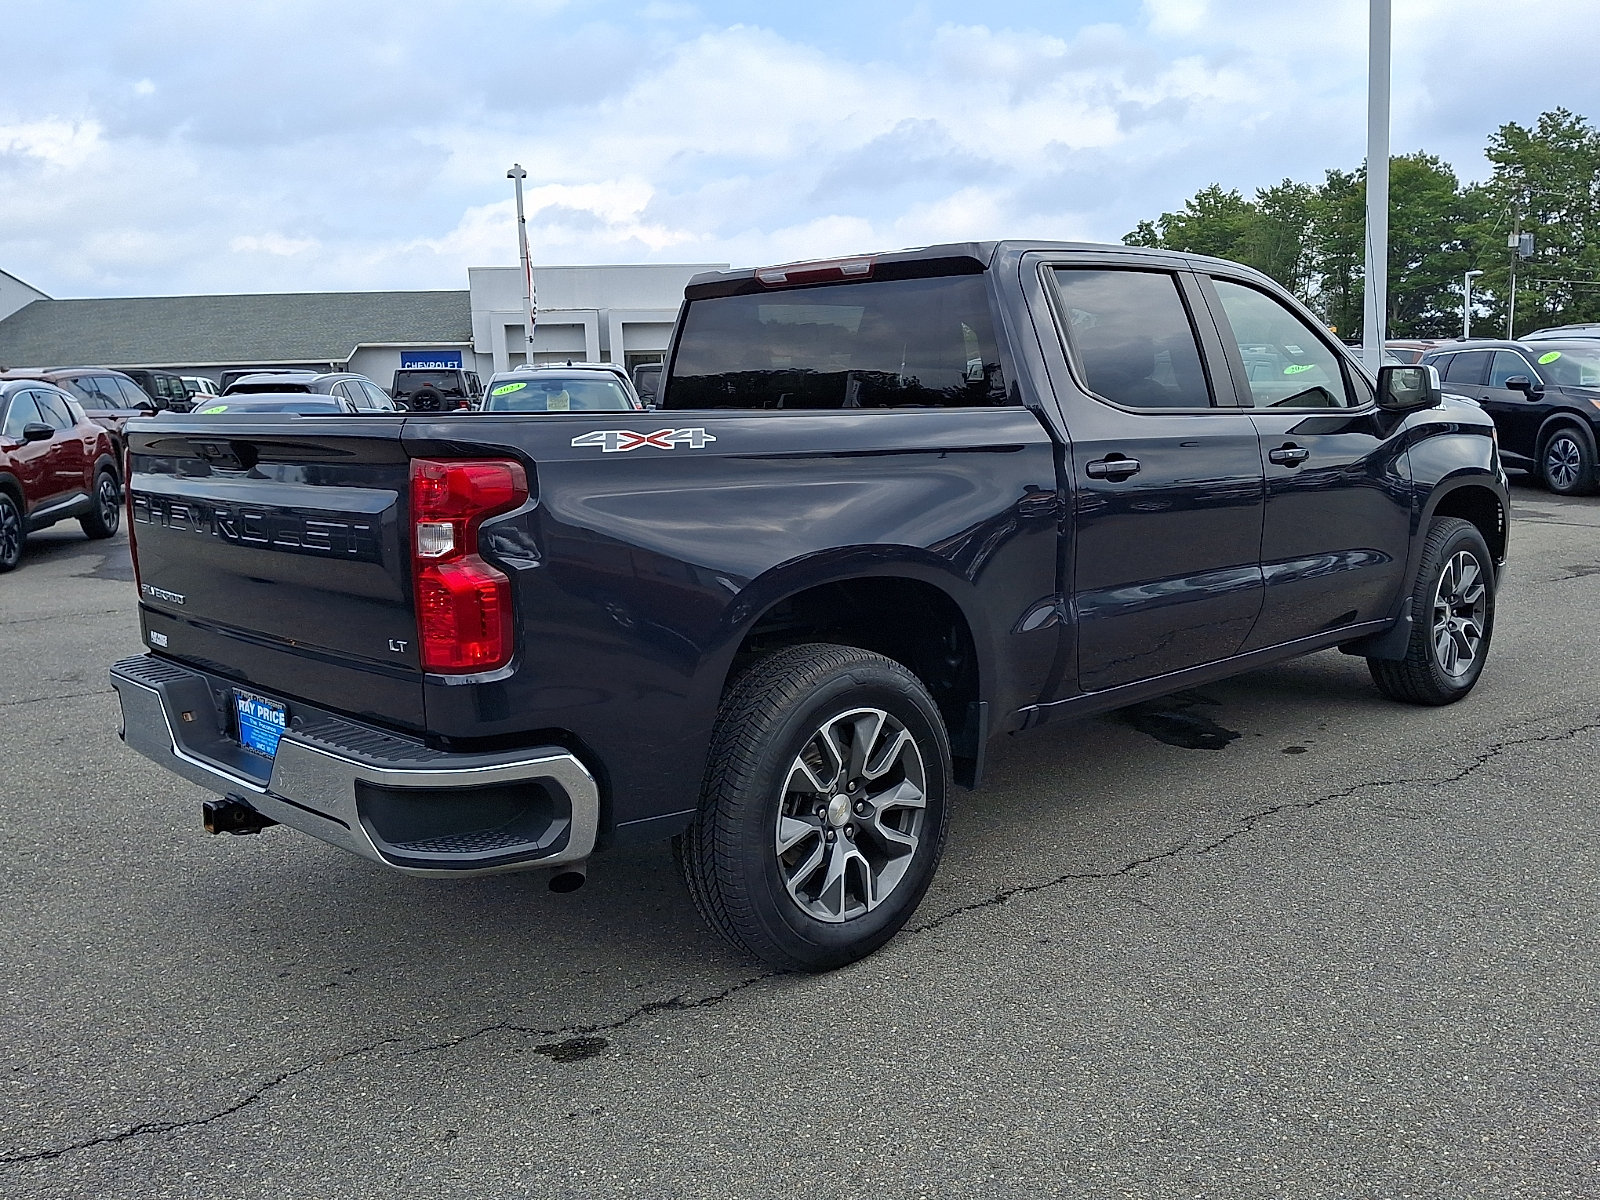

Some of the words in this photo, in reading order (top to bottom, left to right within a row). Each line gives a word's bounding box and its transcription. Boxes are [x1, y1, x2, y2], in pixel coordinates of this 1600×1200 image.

[405, 361, 459, 369] CHEVROLET
[134, 494, 371, 554] CHEVROLET
[388, 639, 408, 653] LT
[238, 699, 256, 716] RAY
[257, 705, 286, 727] PRICE
